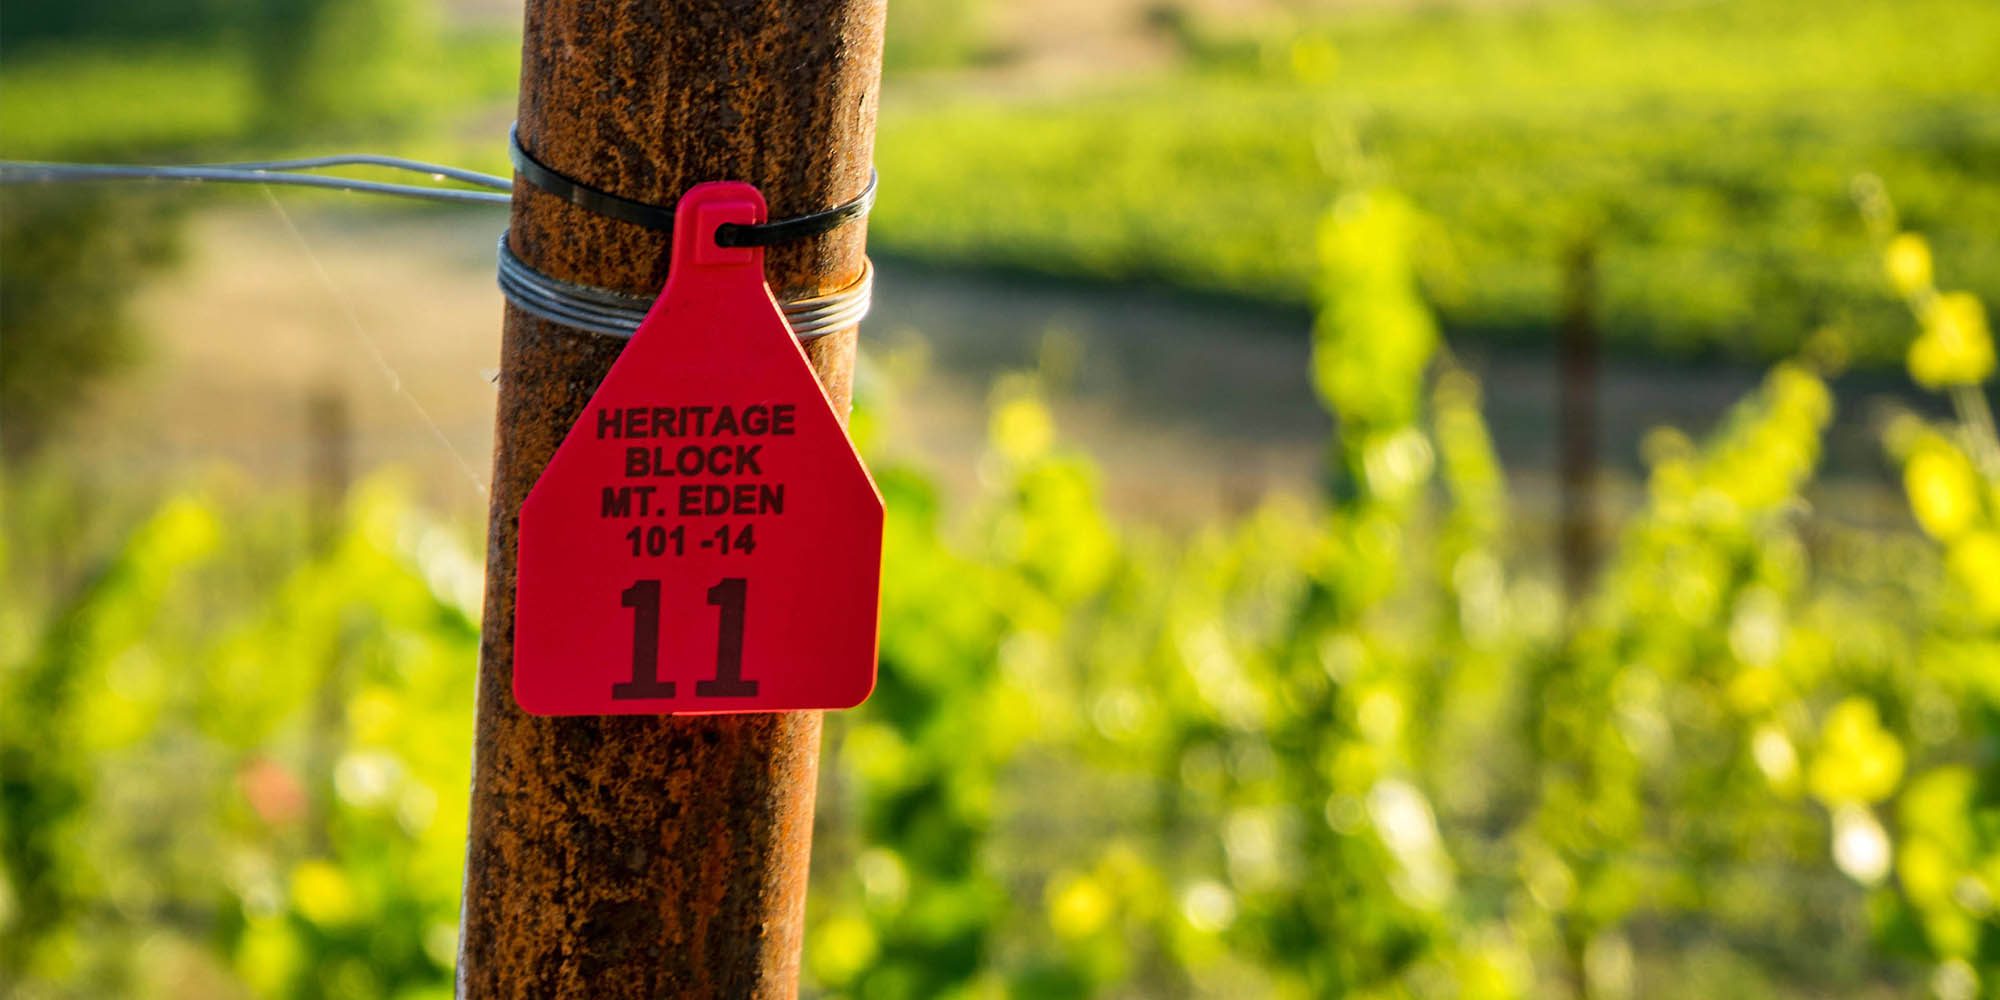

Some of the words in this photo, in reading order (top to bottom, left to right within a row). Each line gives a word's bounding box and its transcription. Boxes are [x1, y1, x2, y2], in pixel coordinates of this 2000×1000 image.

[596, 404, 797, 440] HERITAGE
[624, 444, 763, 478] BLOCK
[600, 485, 667, 519] MT.
[677, 483, 785, 517] EDEN
[611, 577, 760, 701] 11
